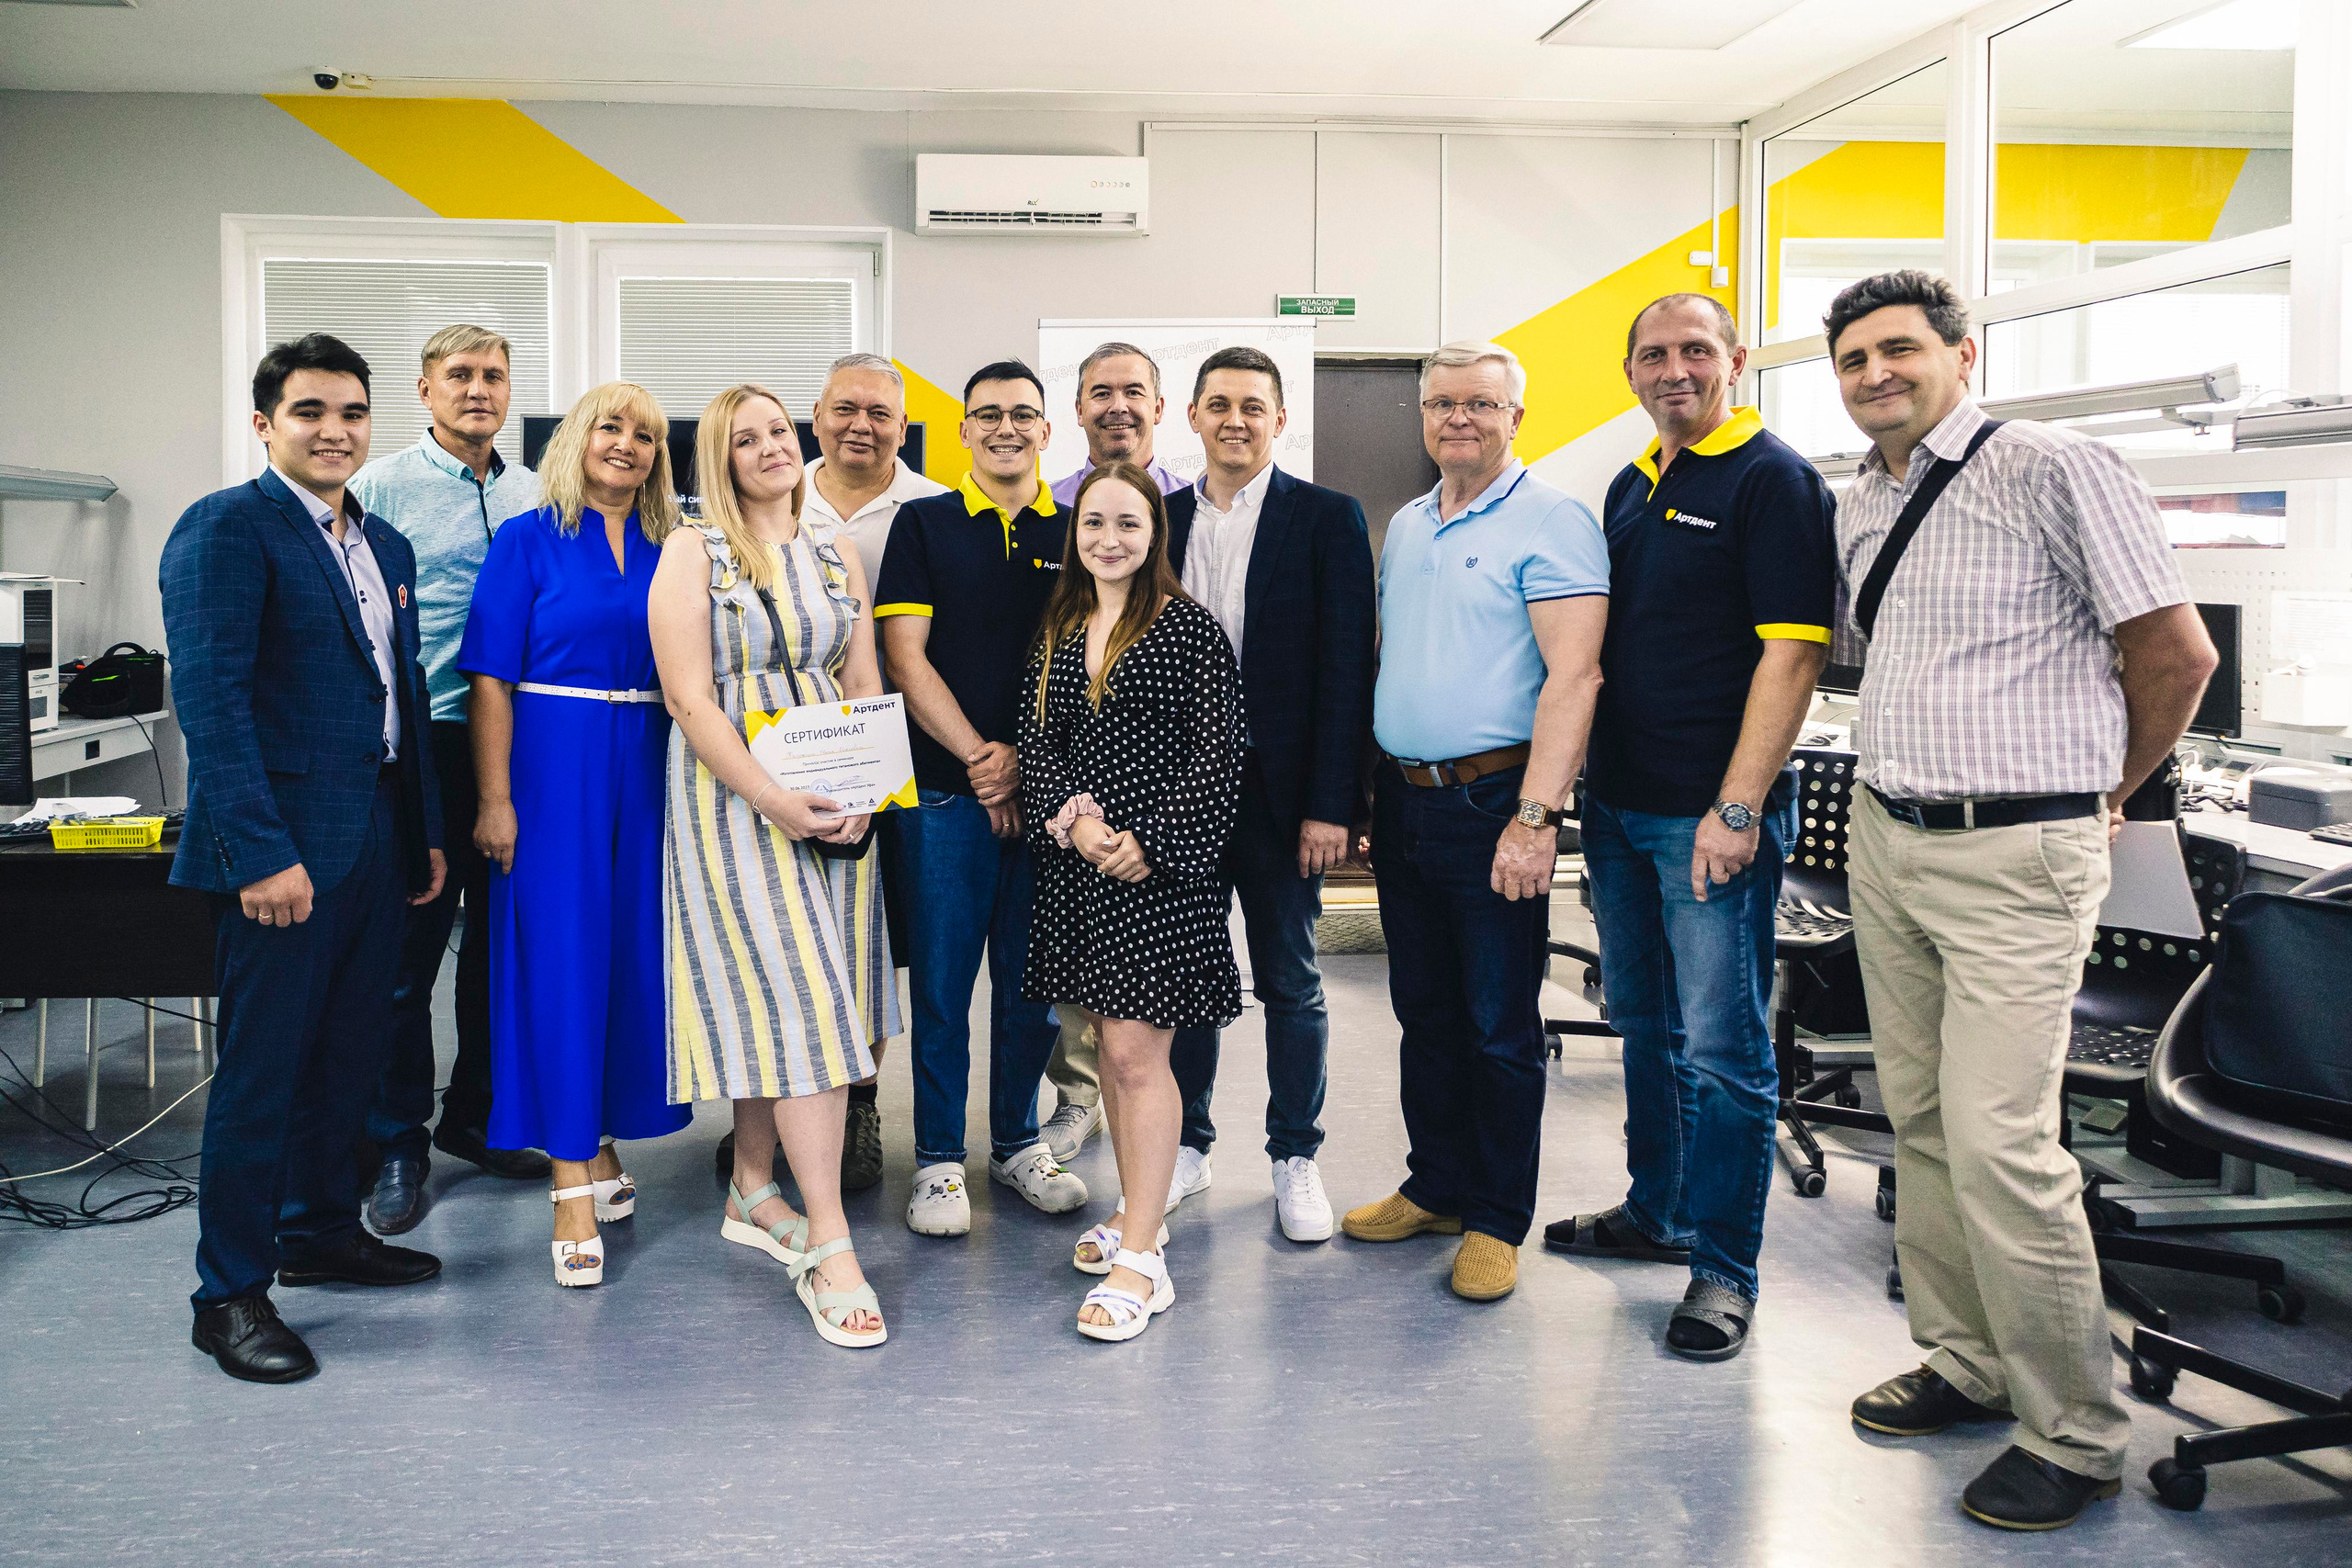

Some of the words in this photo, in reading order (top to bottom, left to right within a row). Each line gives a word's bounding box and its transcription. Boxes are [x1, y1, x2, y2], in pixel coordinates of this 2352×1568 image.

[1301, 306, 1335, 315] ВЫХОД
[1673, 512, 1717, 529] Артдент
[853, 702, 896, 714] Артдент
[784, 722, 865, 744] СЕРТИФИКАТ
